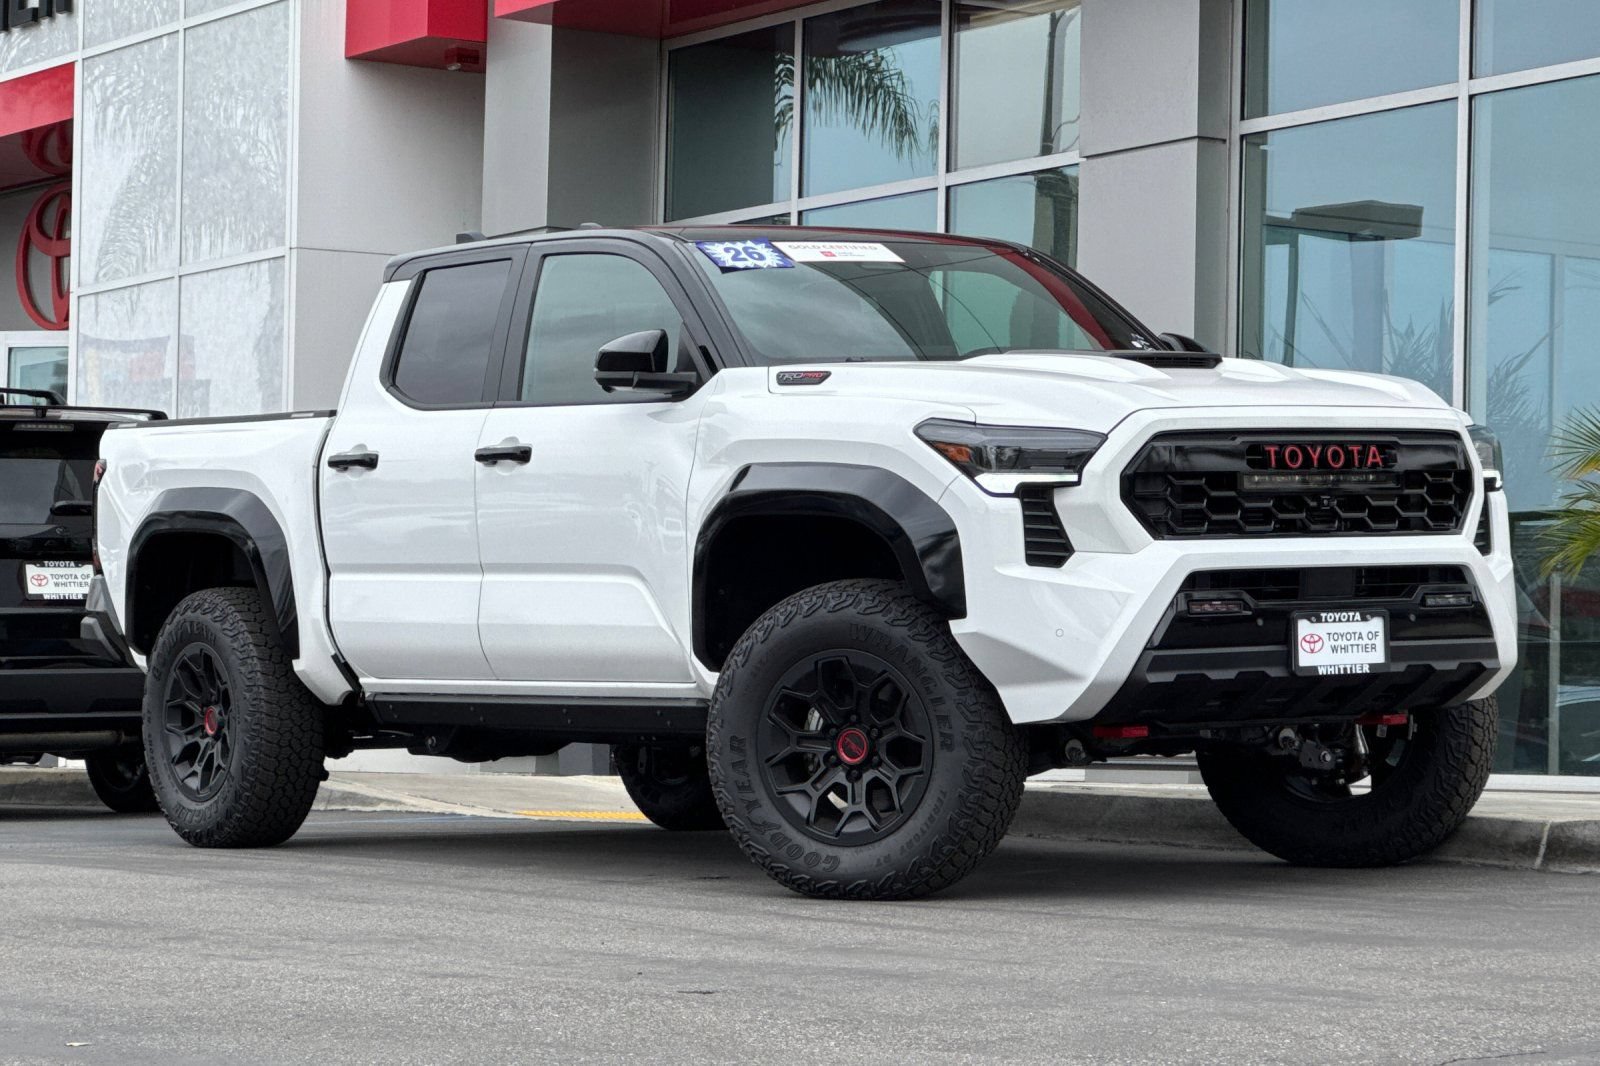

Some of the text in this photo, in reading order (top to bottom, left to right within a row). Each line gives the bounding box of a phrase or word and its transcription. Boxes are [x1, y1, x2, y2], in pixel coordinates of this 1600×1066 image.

[723, 246, 766, 261] 26
[1264, 444, 1384, 469] TOYOTA
[1320, 612, 1361, 622] TOYOTA
[1326, 631, 1380, 642] TOYOTA OF
[1330, 643, 1377, 654] WHITTIER
[1317, 663, 1370, 676] WHITTIER
[848, 622, 956, 753] WRANGLER
[729, 734, 841, 872] GOODYEAR
